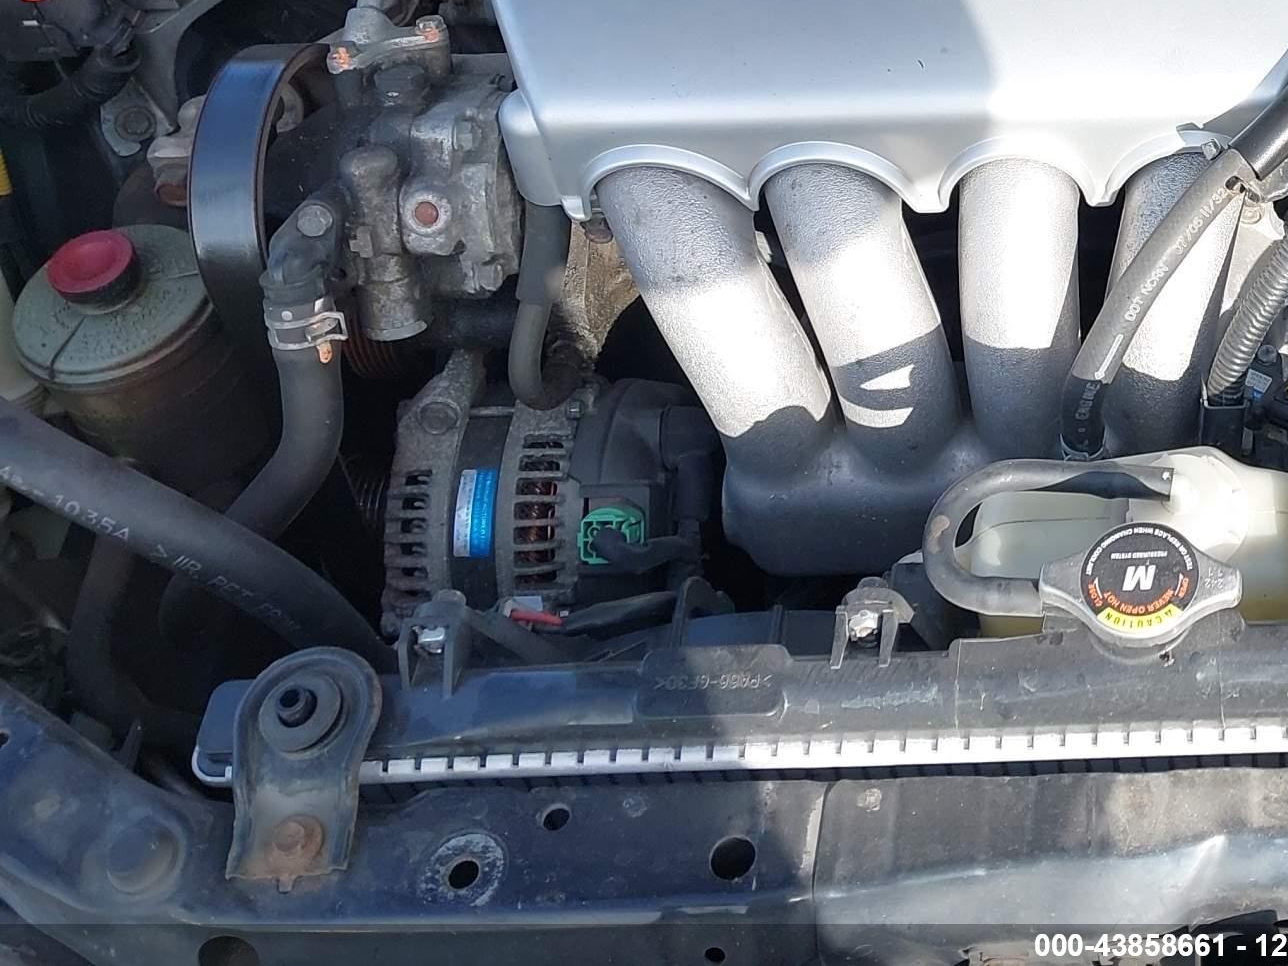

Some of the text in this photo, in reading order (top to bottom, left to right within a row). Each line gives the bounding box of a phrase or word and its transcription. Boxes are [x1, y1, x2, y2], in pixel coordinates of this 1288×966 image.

[1124, 296, 1144, 322] DOT
[1133, 527, 1154, 535] WHEN
[1103, 588, 1175, 615] NEVER OPEN HOT
[1105, 611, 1163, 629] CAUTION
